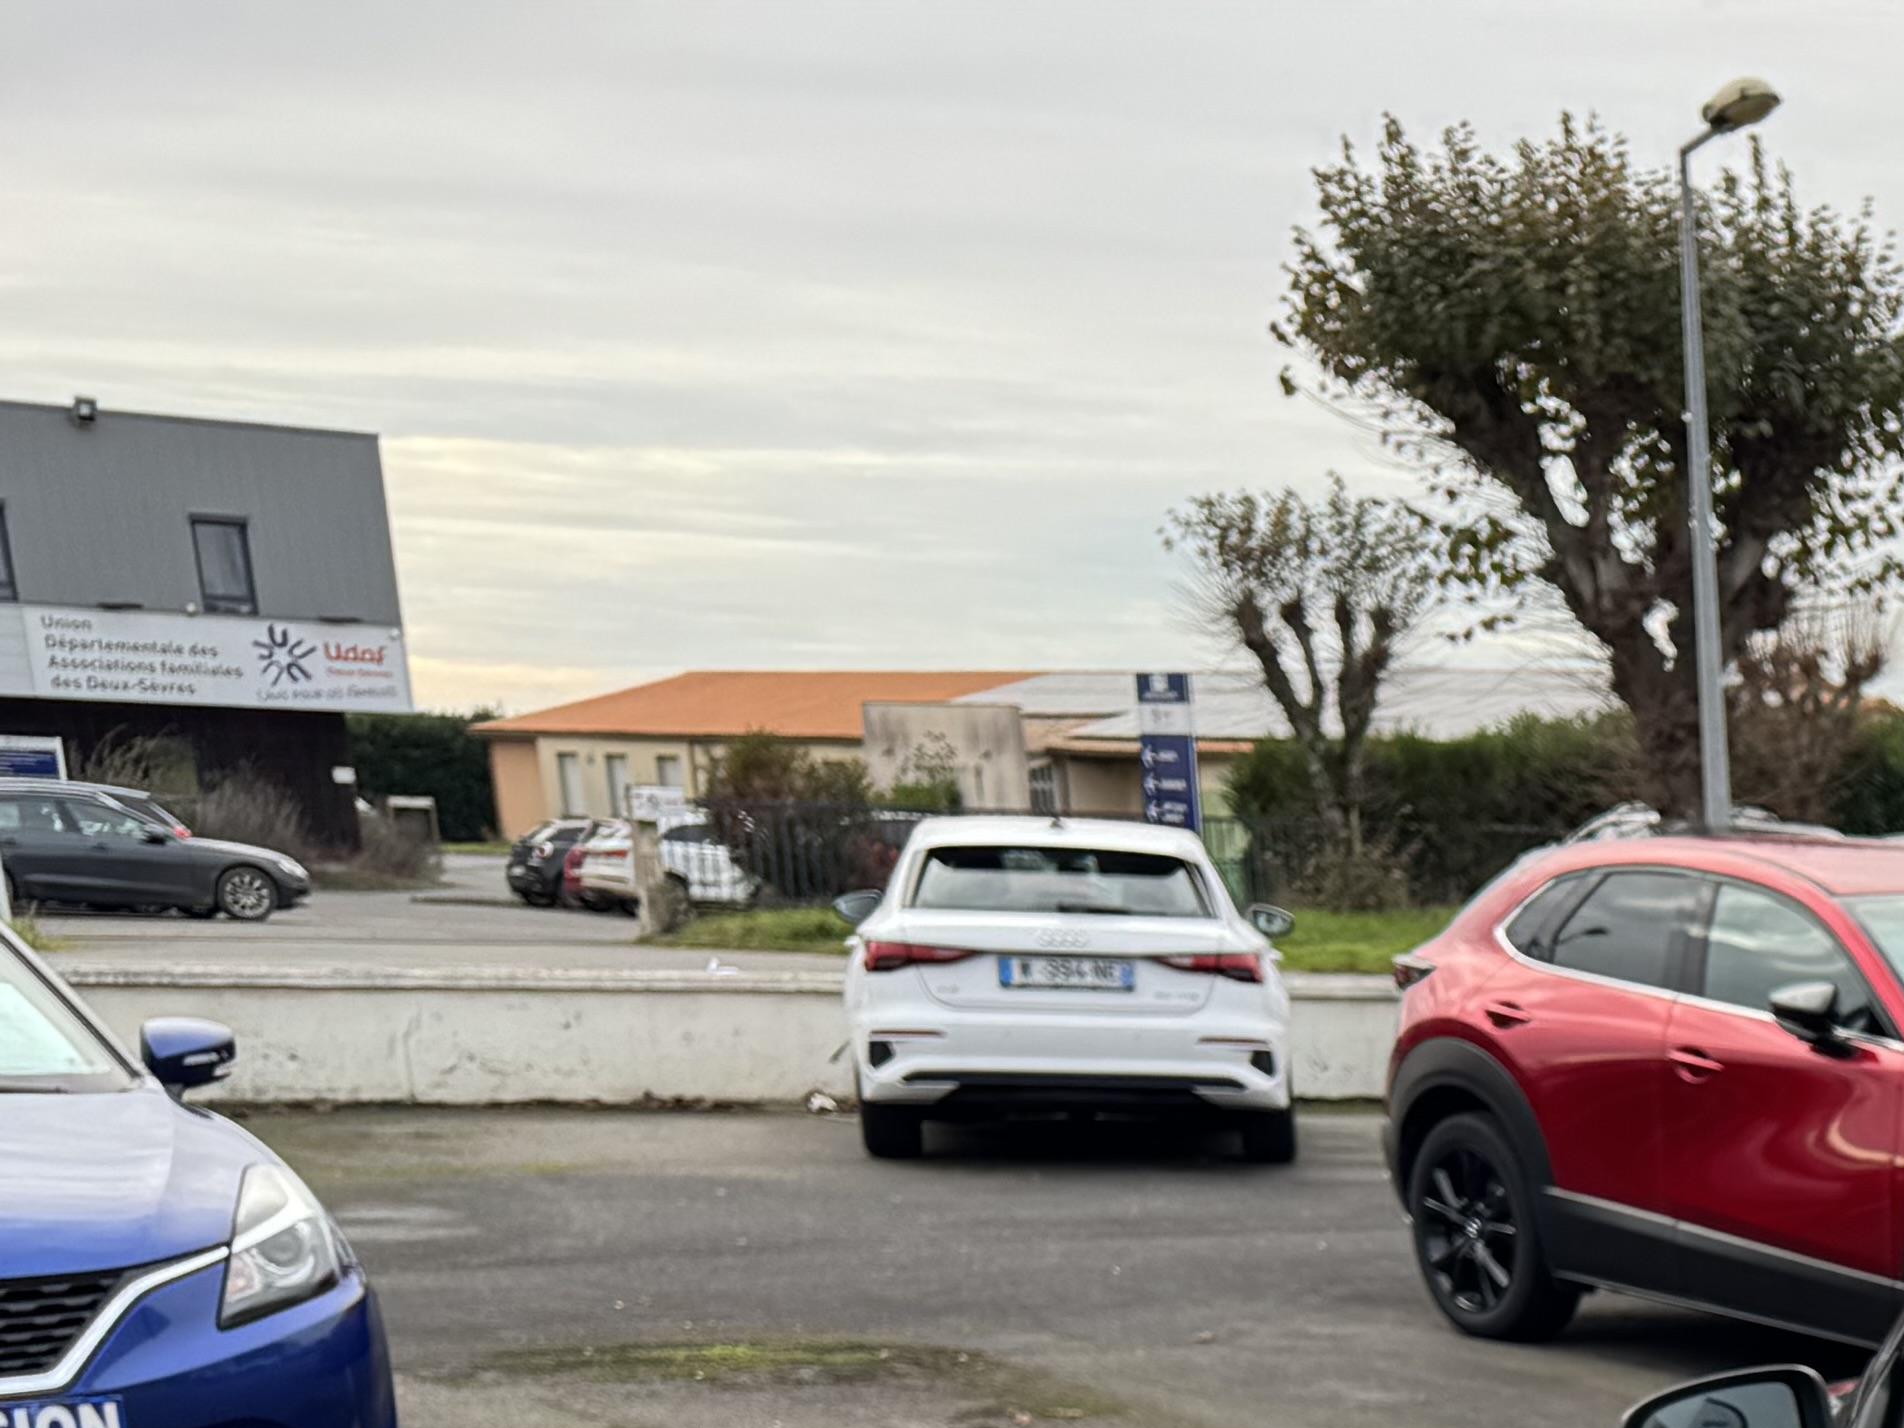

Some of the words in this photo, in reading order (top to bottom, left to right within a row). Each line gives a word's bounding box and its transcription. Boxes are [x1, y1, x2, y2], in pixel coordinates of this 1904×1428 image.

[40, 614, 92, 631] Union
[44, 633, 184, 656] Départementale
[188, 643, 218, 658] des
[322, 639, 386, 665] Udaf
[48, 654, 156, 674] Associations
[160, 659, 243, 678] familiales
[51, 674, 82, 690] des
[86, 674, 197, 695] Deux-Sèvres
